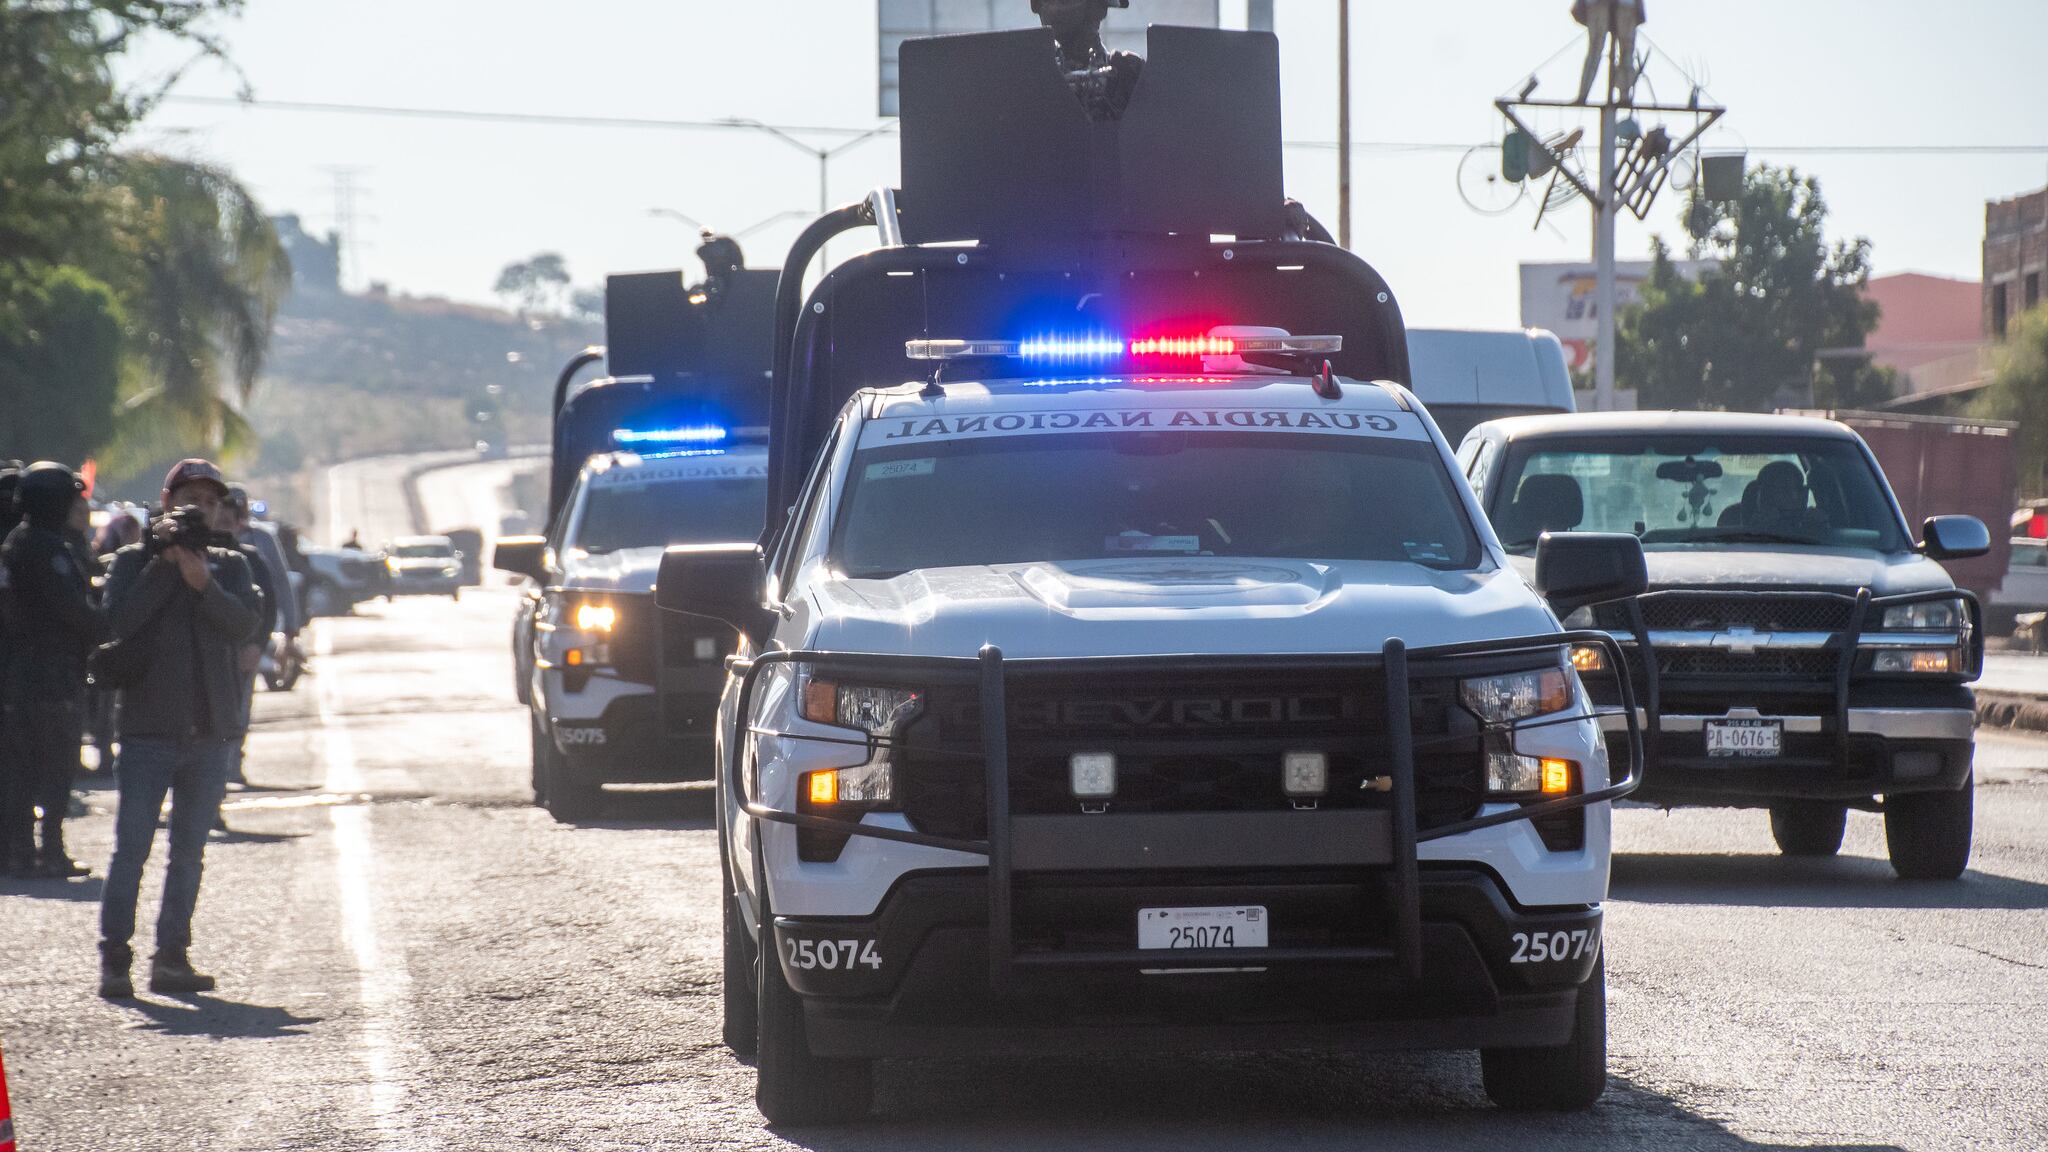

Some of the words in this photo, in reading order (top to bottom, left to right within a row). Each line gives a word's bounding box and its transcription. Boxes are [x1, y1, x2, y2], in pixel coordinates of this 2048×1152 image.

[1706, 729, 1780, 748] PA-0676-B
[1169, 925, 1235, 948] 25074
[1510, 928, 1596, 963] 25074
[786, 938, 883, 970] 25074
